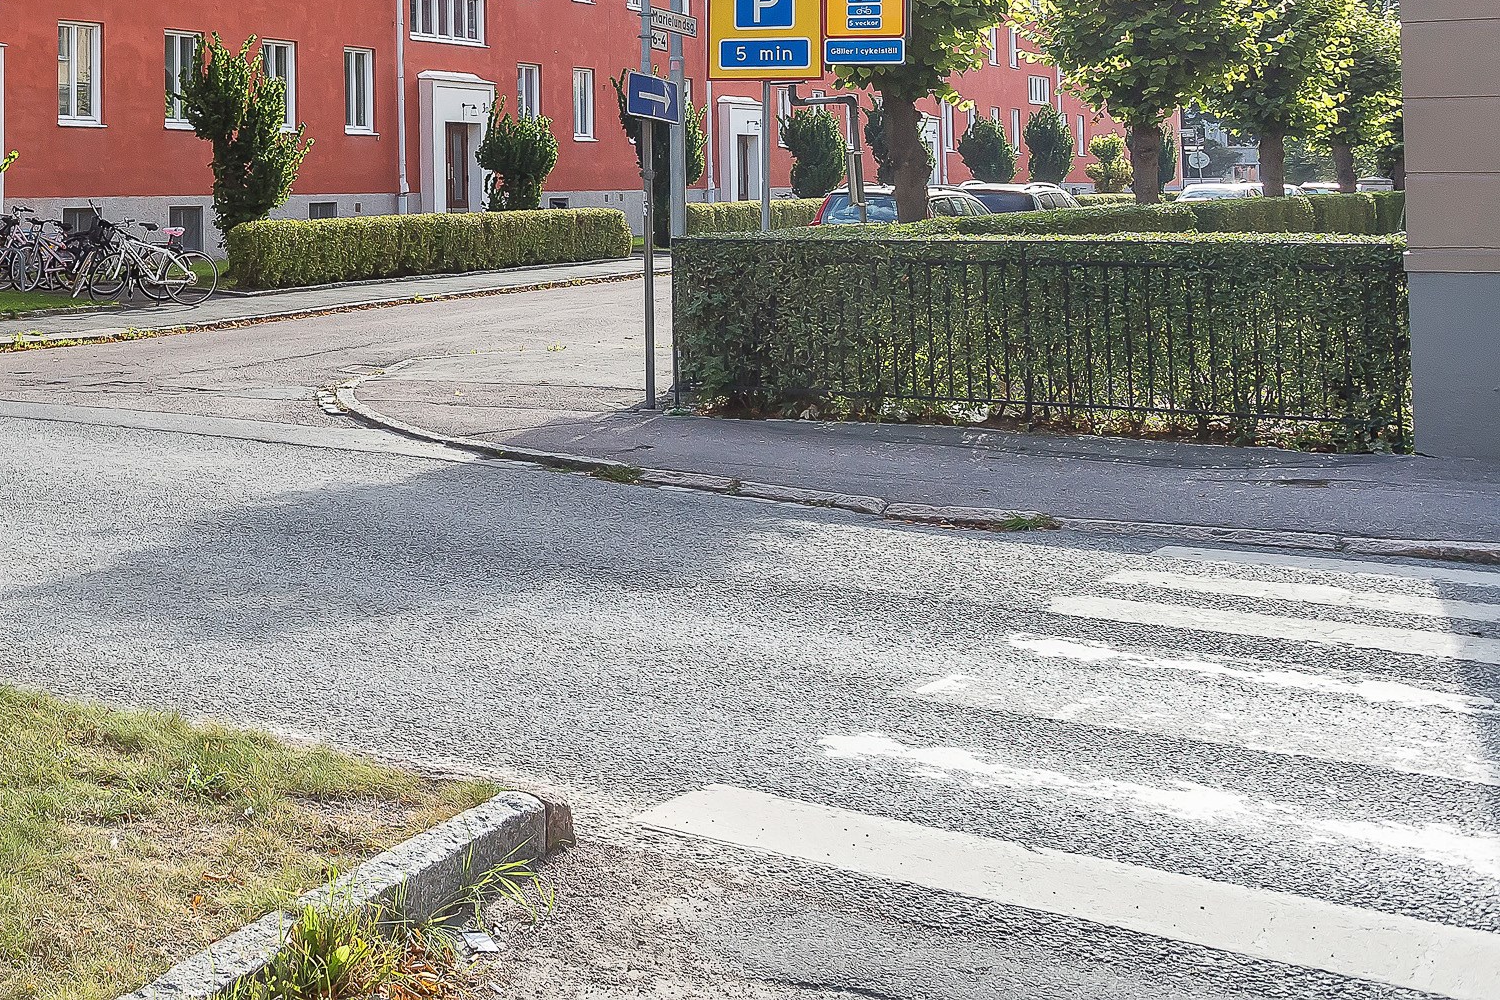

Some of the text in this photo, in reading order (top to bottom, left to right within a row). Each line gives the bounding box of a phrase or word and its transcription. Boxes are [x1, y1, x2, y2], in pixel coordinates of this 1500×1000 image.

[651, 9, 696, 36] Marielundsg.
[651, 32, 666, 47] 6-4
[735, 45, 793, 61] 5 min
[860, 46, 898, 56] cykelställ
